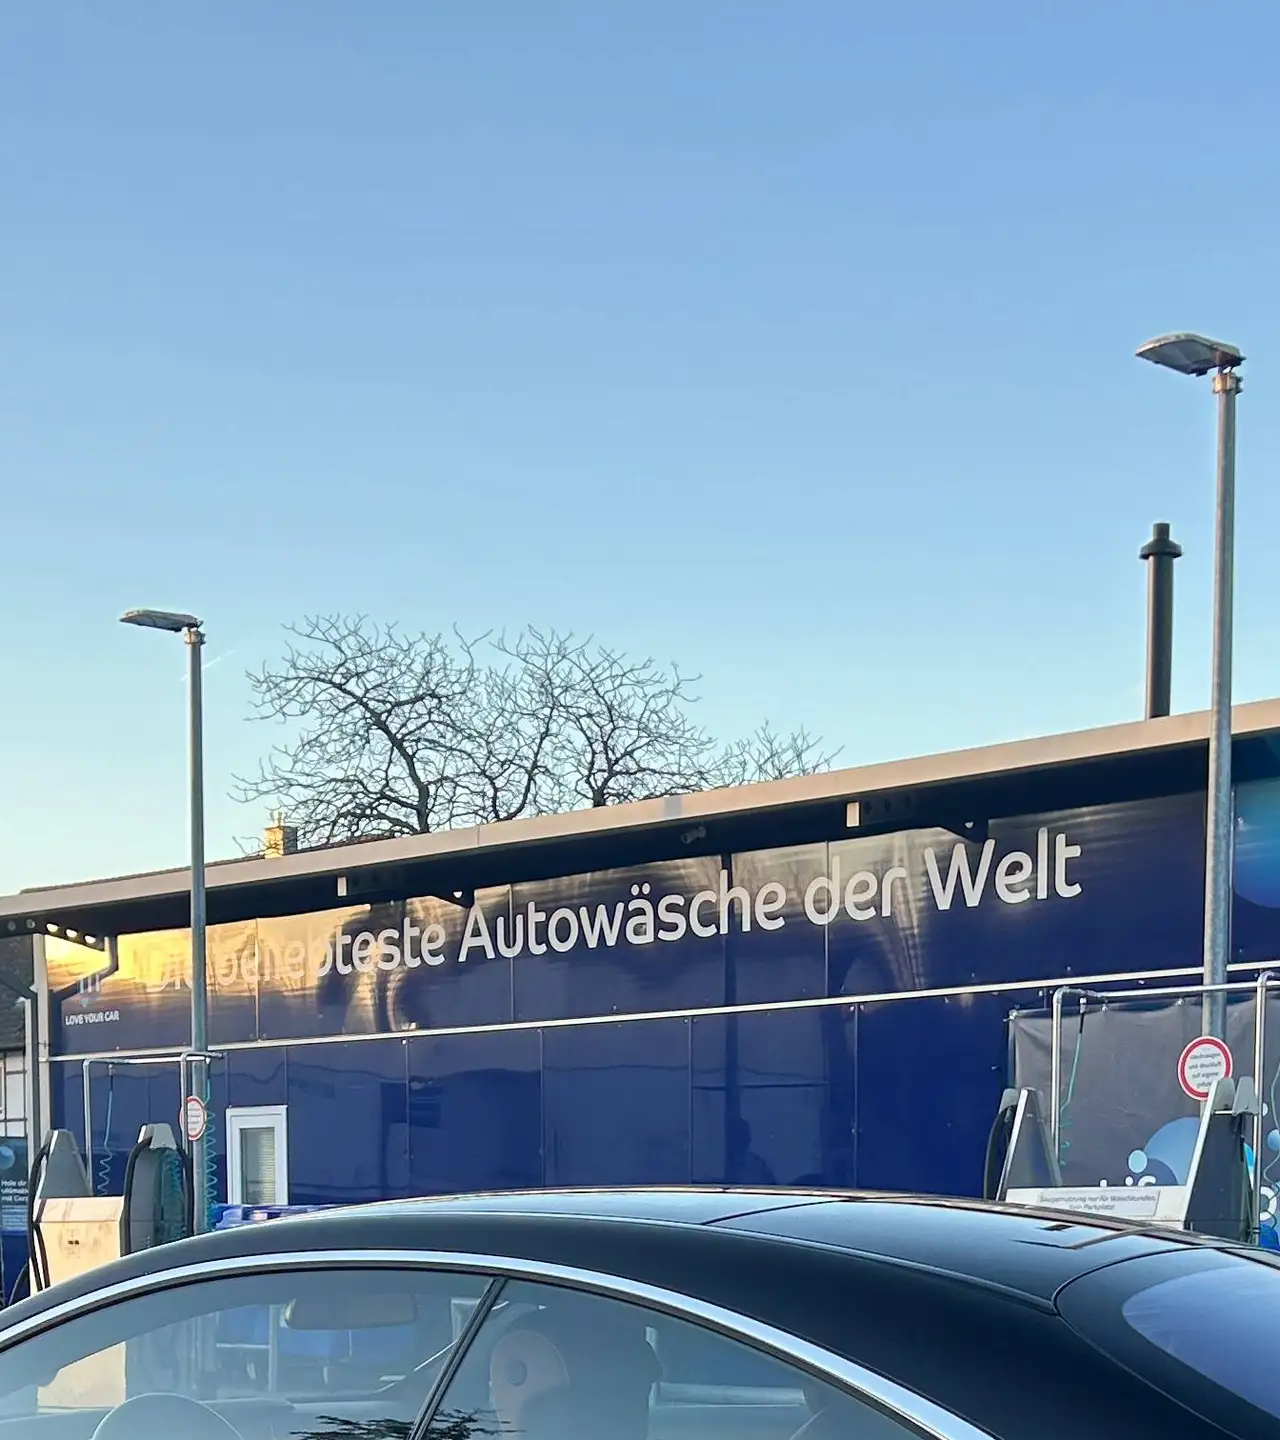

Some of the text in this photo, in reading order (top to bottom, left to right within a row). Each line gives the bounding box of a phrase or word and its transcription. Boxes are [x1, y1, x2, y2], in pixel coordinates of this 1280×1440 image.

[458, 869, 787, 963] Autowäsche
[804, 855, 908, 926] der
[924, 827, 1083, 911] Welt
[65, 1010, 120, 1026] LOVE YOUR CAR
